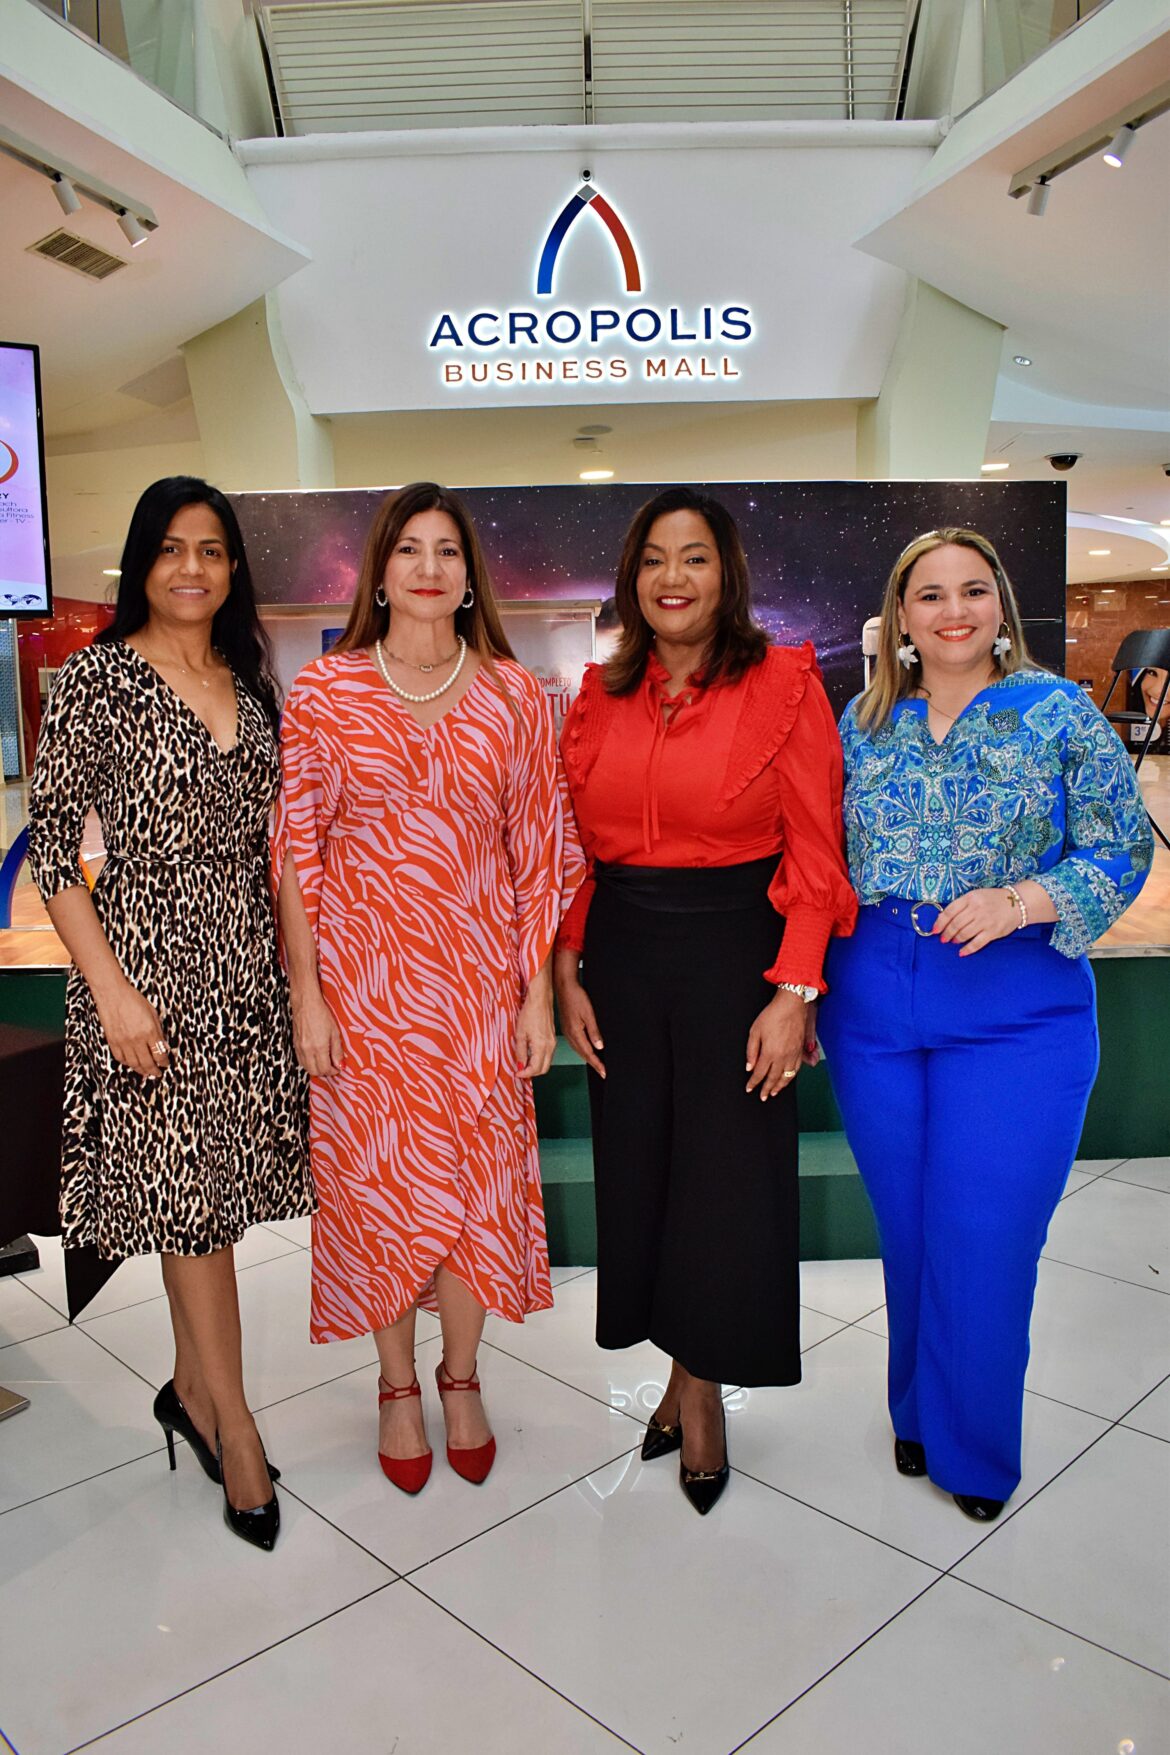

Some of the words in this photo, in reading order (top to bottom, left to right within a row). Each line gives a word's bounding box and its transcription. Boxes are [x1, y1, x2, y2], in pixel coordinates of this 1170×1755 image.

[430, 307, 752, 347] ACROPOLIS
[445, 359, 628, 382] BUSINESS
[646, 357, 739, 377] MALL
